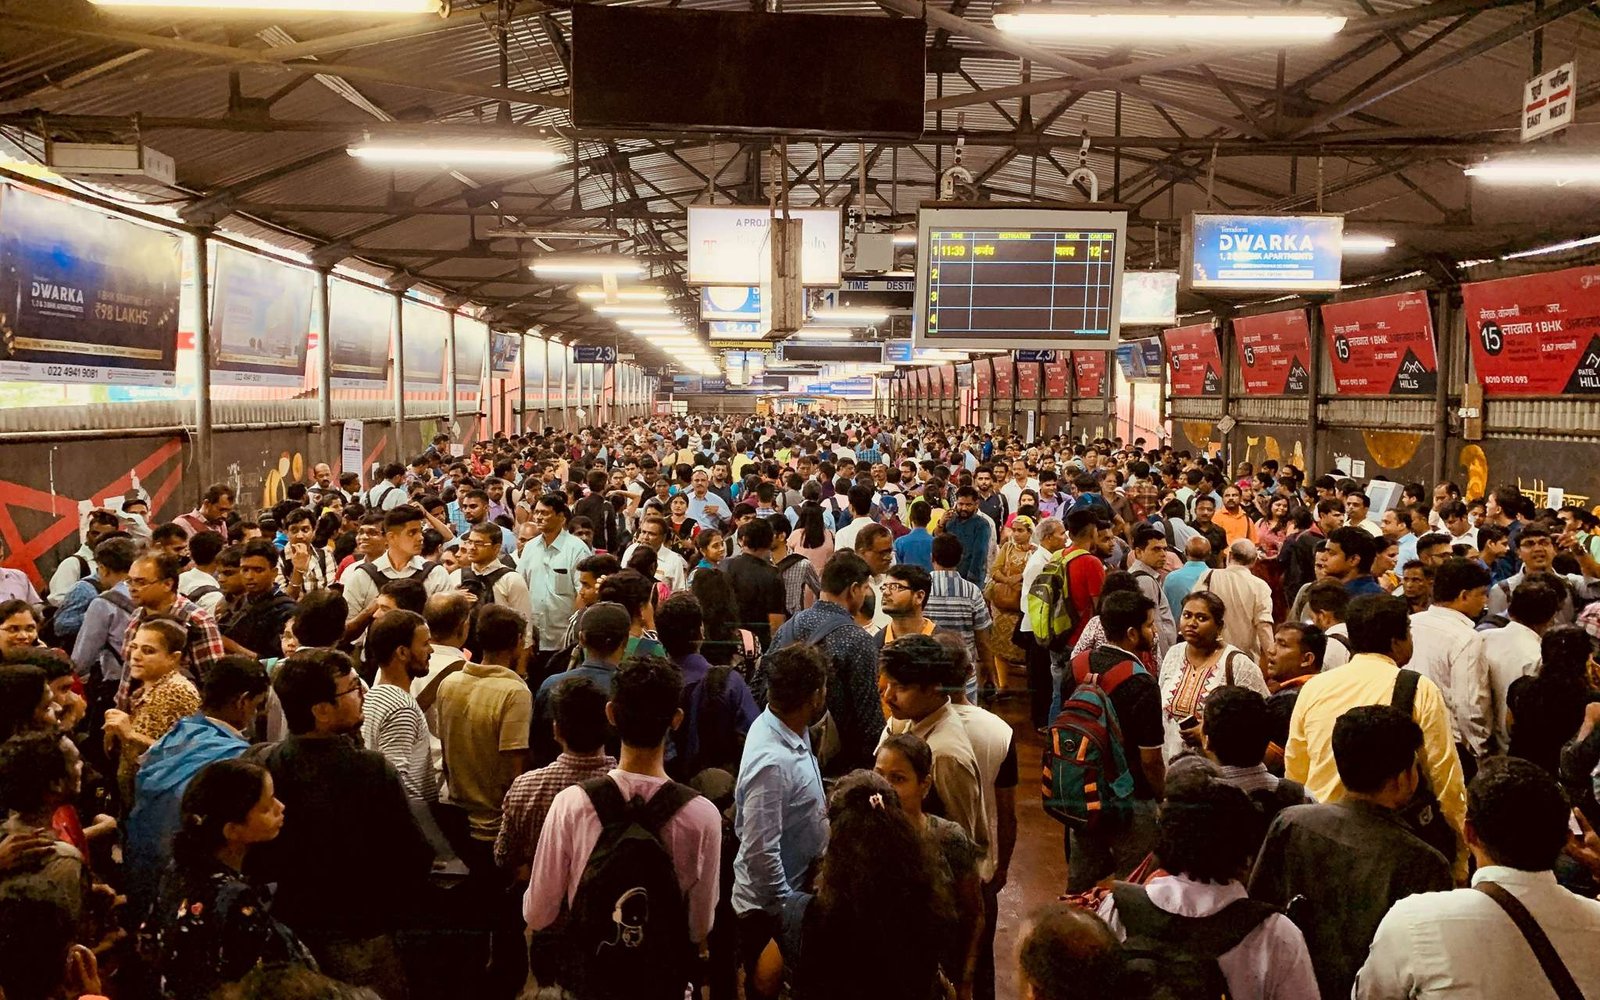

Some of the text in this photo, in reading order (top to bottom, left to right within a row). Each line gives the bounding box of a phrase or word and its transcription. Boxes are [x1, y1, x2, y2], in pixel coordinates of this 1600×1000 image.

[1527, 102, 1567, 129] EAST WEST
[736, 219, 742, 227] A
[1219, 234, 1314, 251] DWARKA
[933, 246, 938, 256] 1
[942, 245, 965, 256] 11:39
[1090, 246, 1100, 256] 12
[931, 268, 937, 279] 2
[847, 282, 869, 290] TIME
[32, 282, 84, 304] DWARKA
[931, 292, 936, 301] 3
[826, 292, 834, 307] 1
[930, 314, 936, 324] 4
[1482, 327, 1500, 350] 15
[1501, 322, 1532, 335] लाखात
[596, 347, 612, 362] 2,3
[1336, 339, 1348, 358] 15
[1036, 350, 1051, 361] 2,3
[1245, 348, 1253, 364] 15
[48, 366, 62, 376] 022
[64, 367, 80, 377] 4941
[82, 368, 98, 378] 9081
[1400, 380, 1418, 388] HILLS
